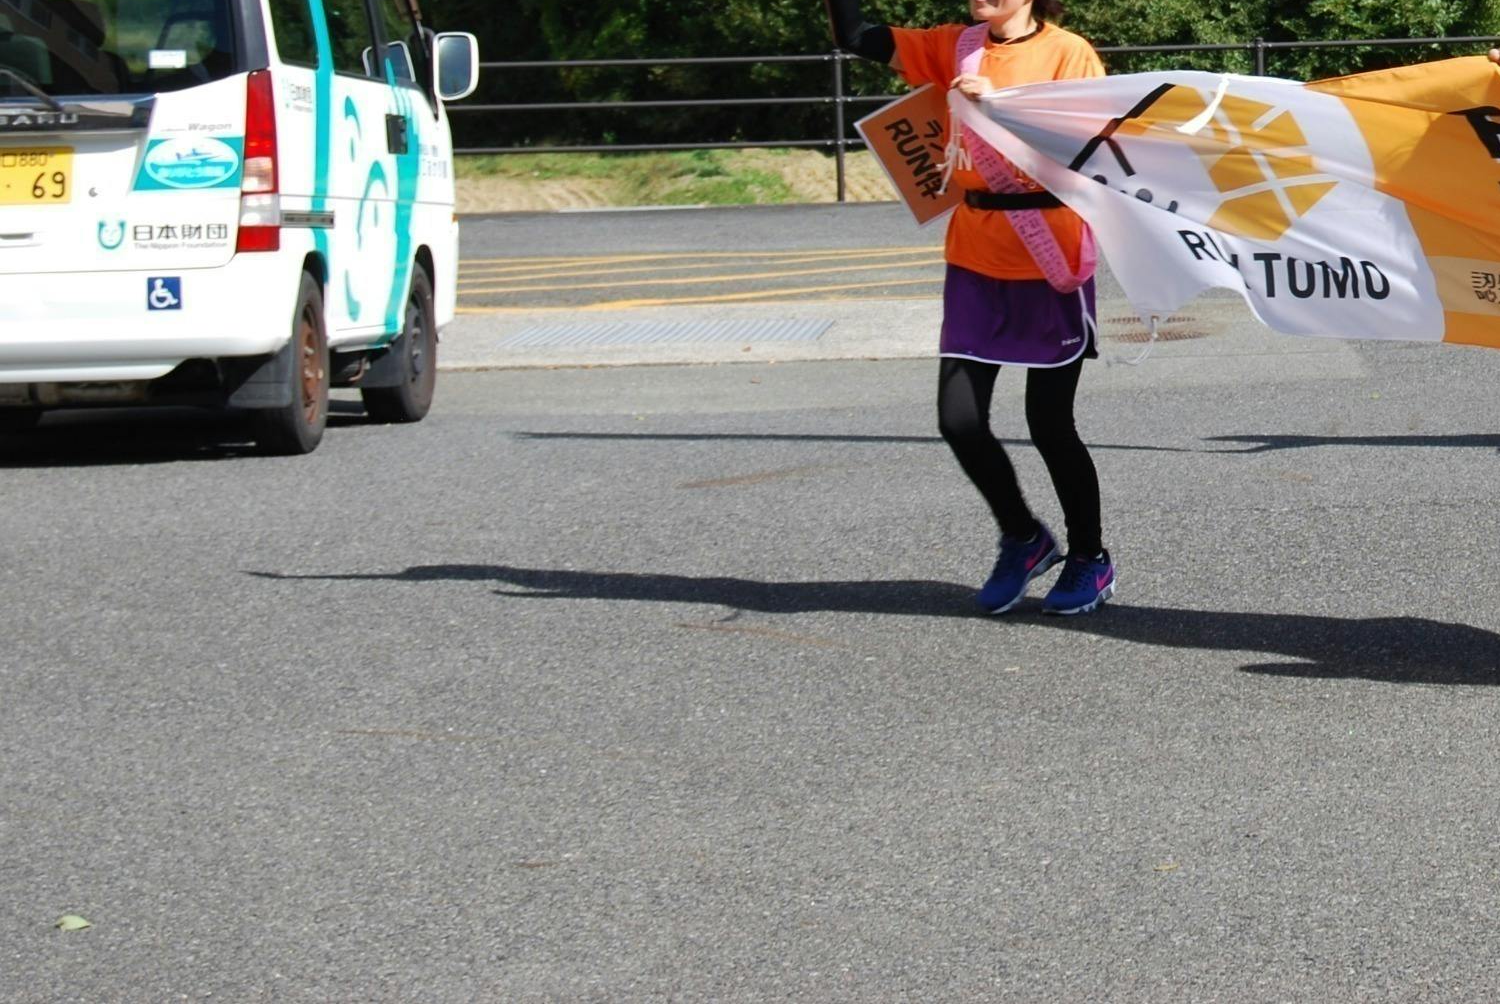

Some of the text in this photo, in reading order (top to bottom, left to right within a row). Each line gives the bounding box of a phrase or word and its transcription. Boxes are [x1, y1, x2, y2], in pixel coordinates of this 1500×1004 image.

[133, 223, 228, 241] 日本財団
[1253, 251, 1390, 300] TOMO
